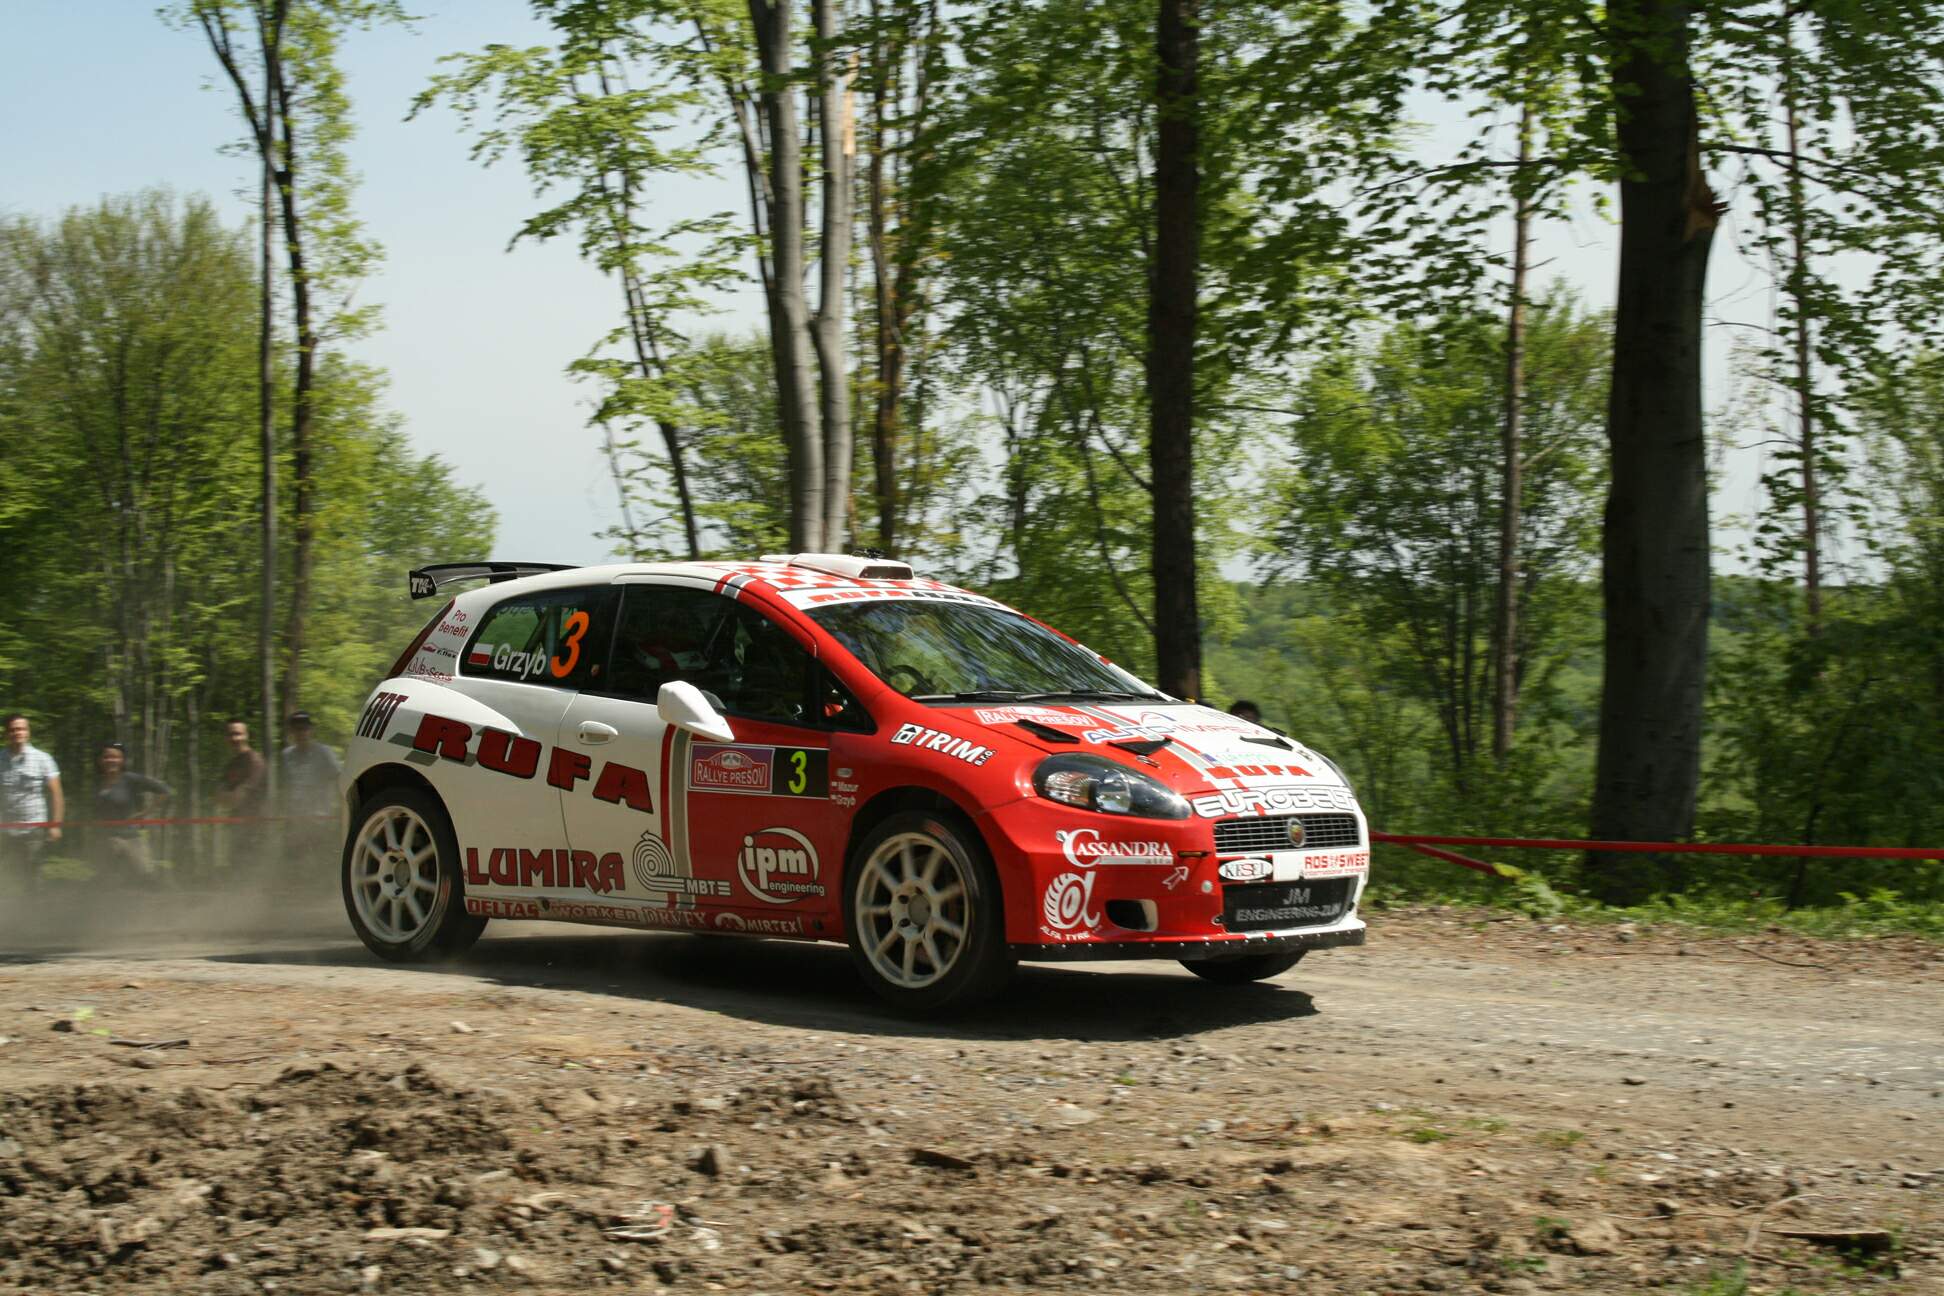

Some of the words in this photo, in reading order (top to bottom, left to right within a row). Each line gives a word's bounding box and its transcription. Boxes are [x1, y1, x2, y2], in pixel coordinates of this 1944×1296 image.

[438, 621, 470, 638] Benefit
[454, 609, 467, 622] Pro
[494, 643, 547, 680] Grzyb
[550, 611, 589, 678] 3
[356, 691, 409, 740] FIAT
[412, 713, 653, 814] RUFA
[915, 729, 986, 763] TRIM
[697, 762, 728, 782] RALLYE
[788, 751, 807, 794] 3
[1204, 764, 1314, 779] RUFA
[743, 835, 808, 889] ipm
[1056, 828, 1174, 867] CASSANDRA
[466, 848, 625, 892] LUMIRA
[687, 880, 716, 895] MBT
[769, 881, 825, 896] engineering
[1283, 888, 1311, 904] JM
